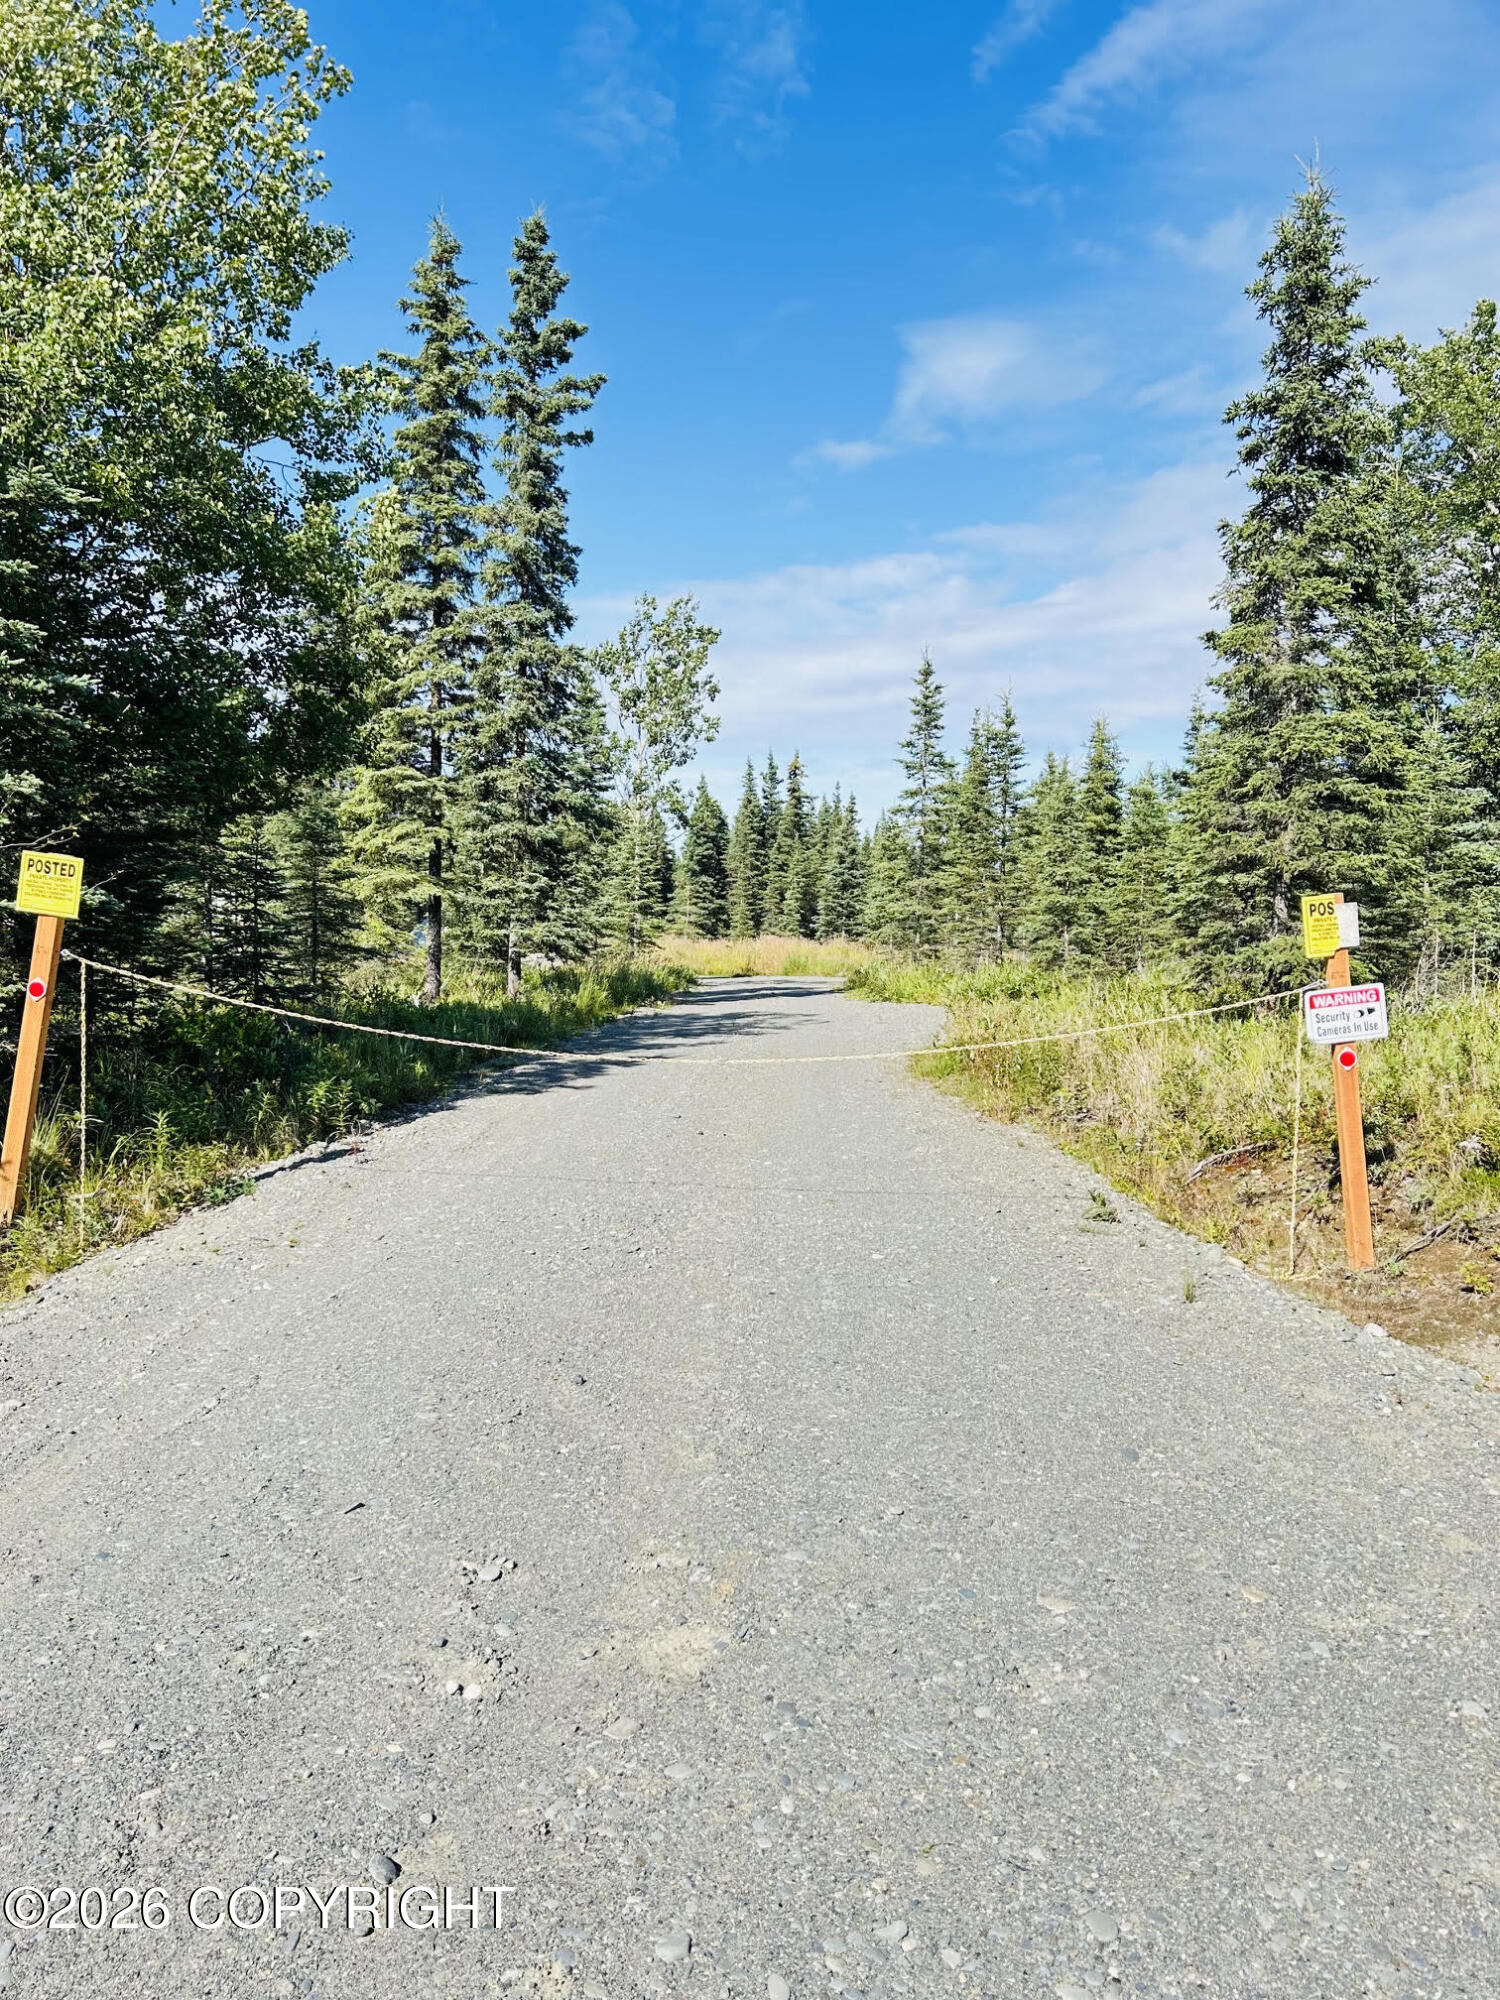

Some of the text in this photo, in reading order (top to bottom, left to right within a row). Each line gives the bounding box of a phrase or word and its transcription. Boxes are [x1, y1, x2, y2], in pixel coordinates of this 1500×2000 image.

[27, 858, 76, 877] POSTED
[1313, 990, 1377, 1009] WARNING
[1315, 1011, 1351, 1024] Security
[1317, 1021, 1379, 1037] Cameras In Use
